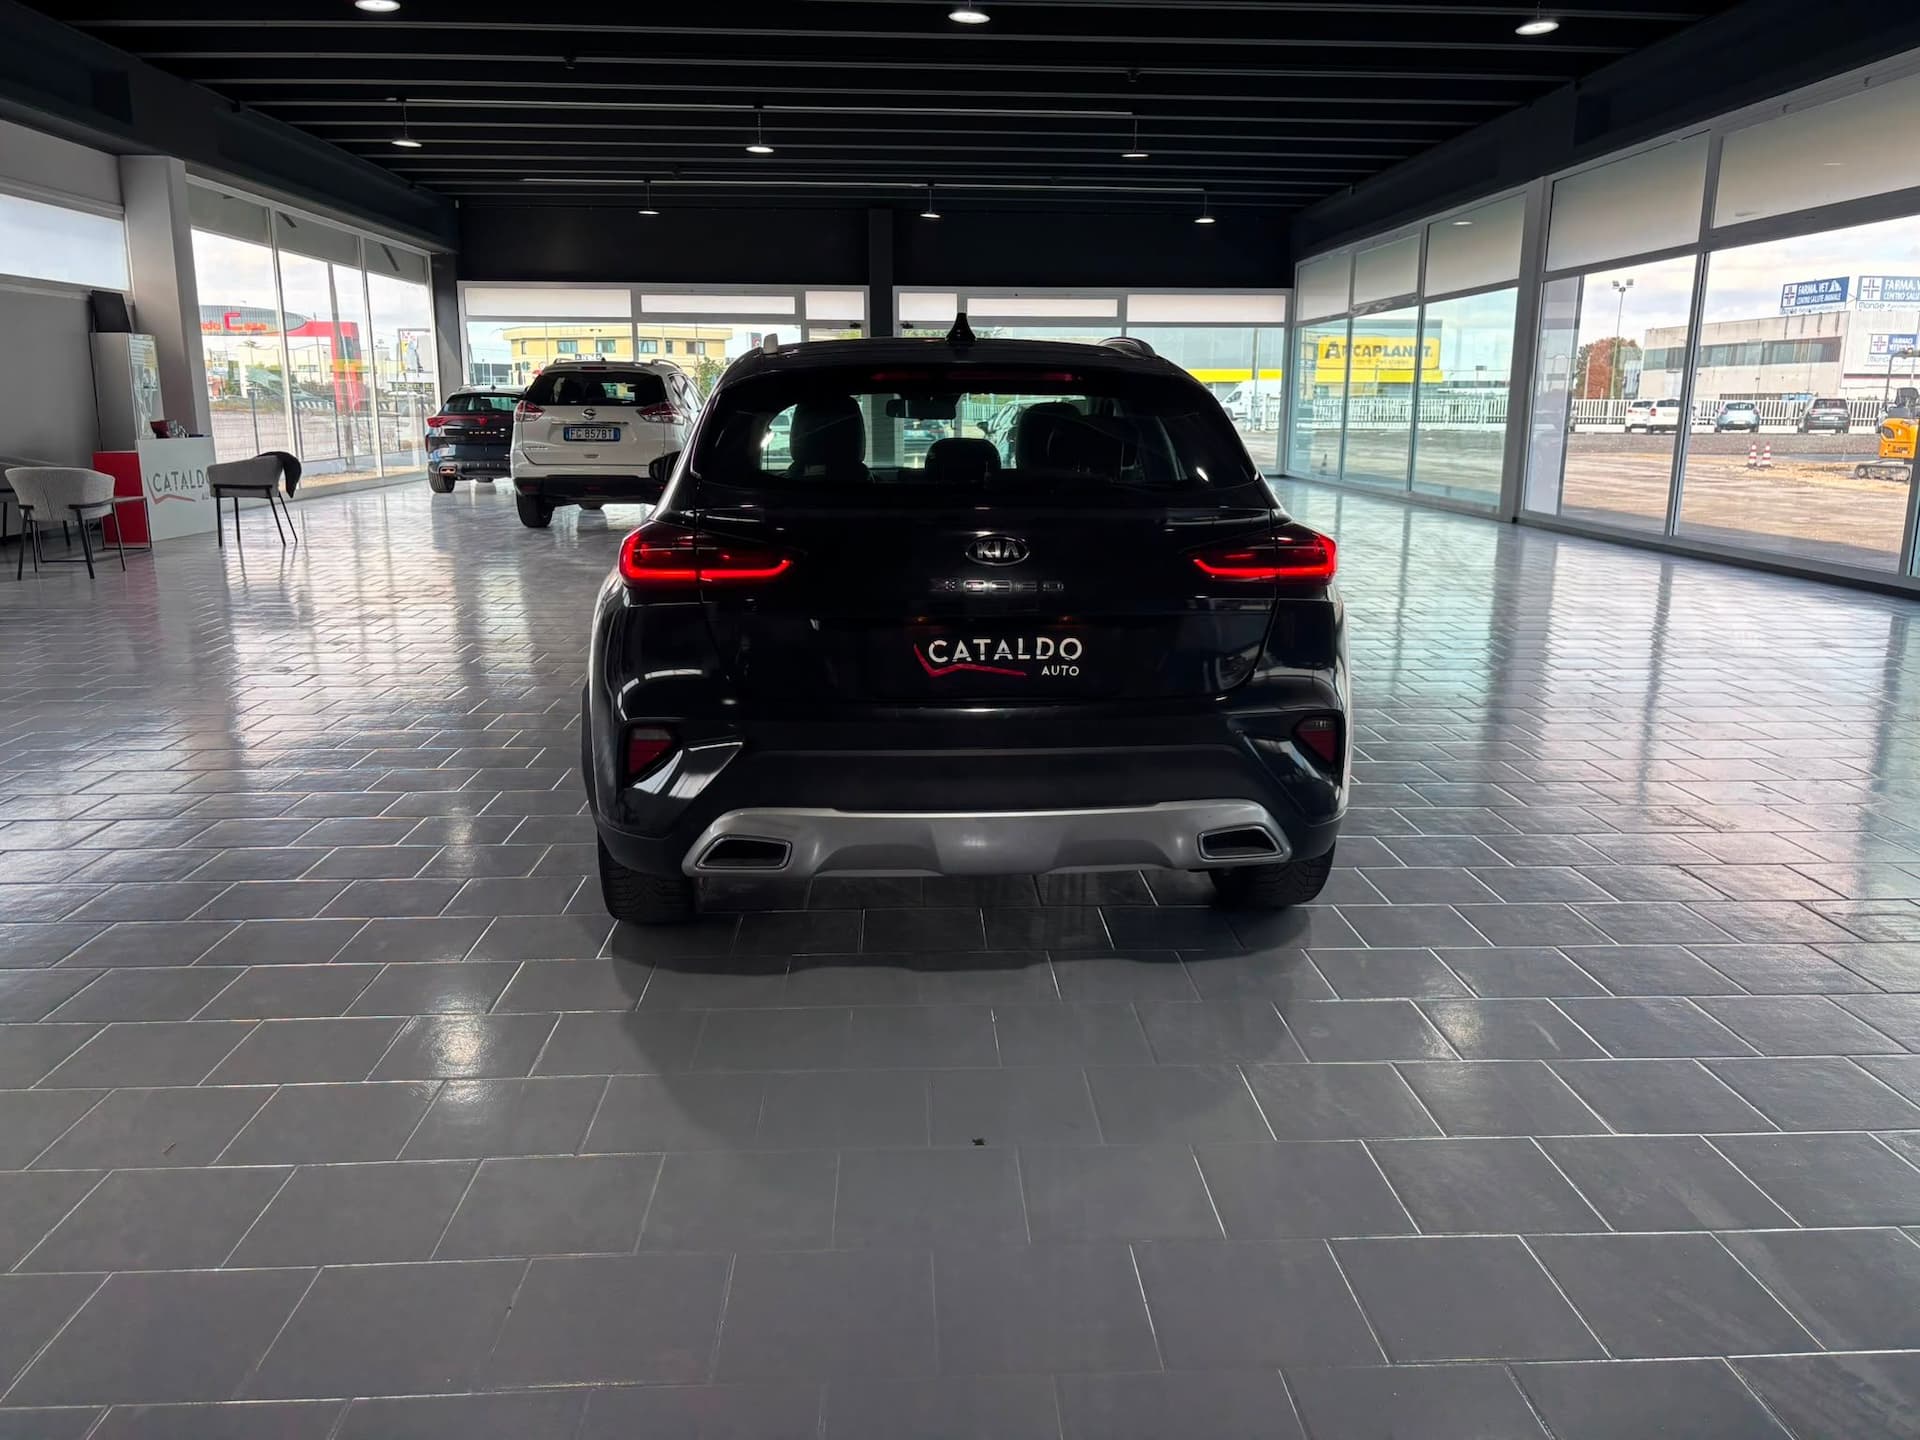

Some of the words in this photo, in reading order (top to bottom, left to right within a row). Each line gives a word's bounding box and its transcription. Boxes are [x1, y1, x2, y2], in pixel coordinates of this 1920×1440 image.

[571, 429, 582, 438] FG
[585, 429, 613, 439] 857BT
[976, 541, 1020, 559] KIA
[928, 637, 1083, 663] CATALDO
[1041, 665, 1080, 677] AUTO
